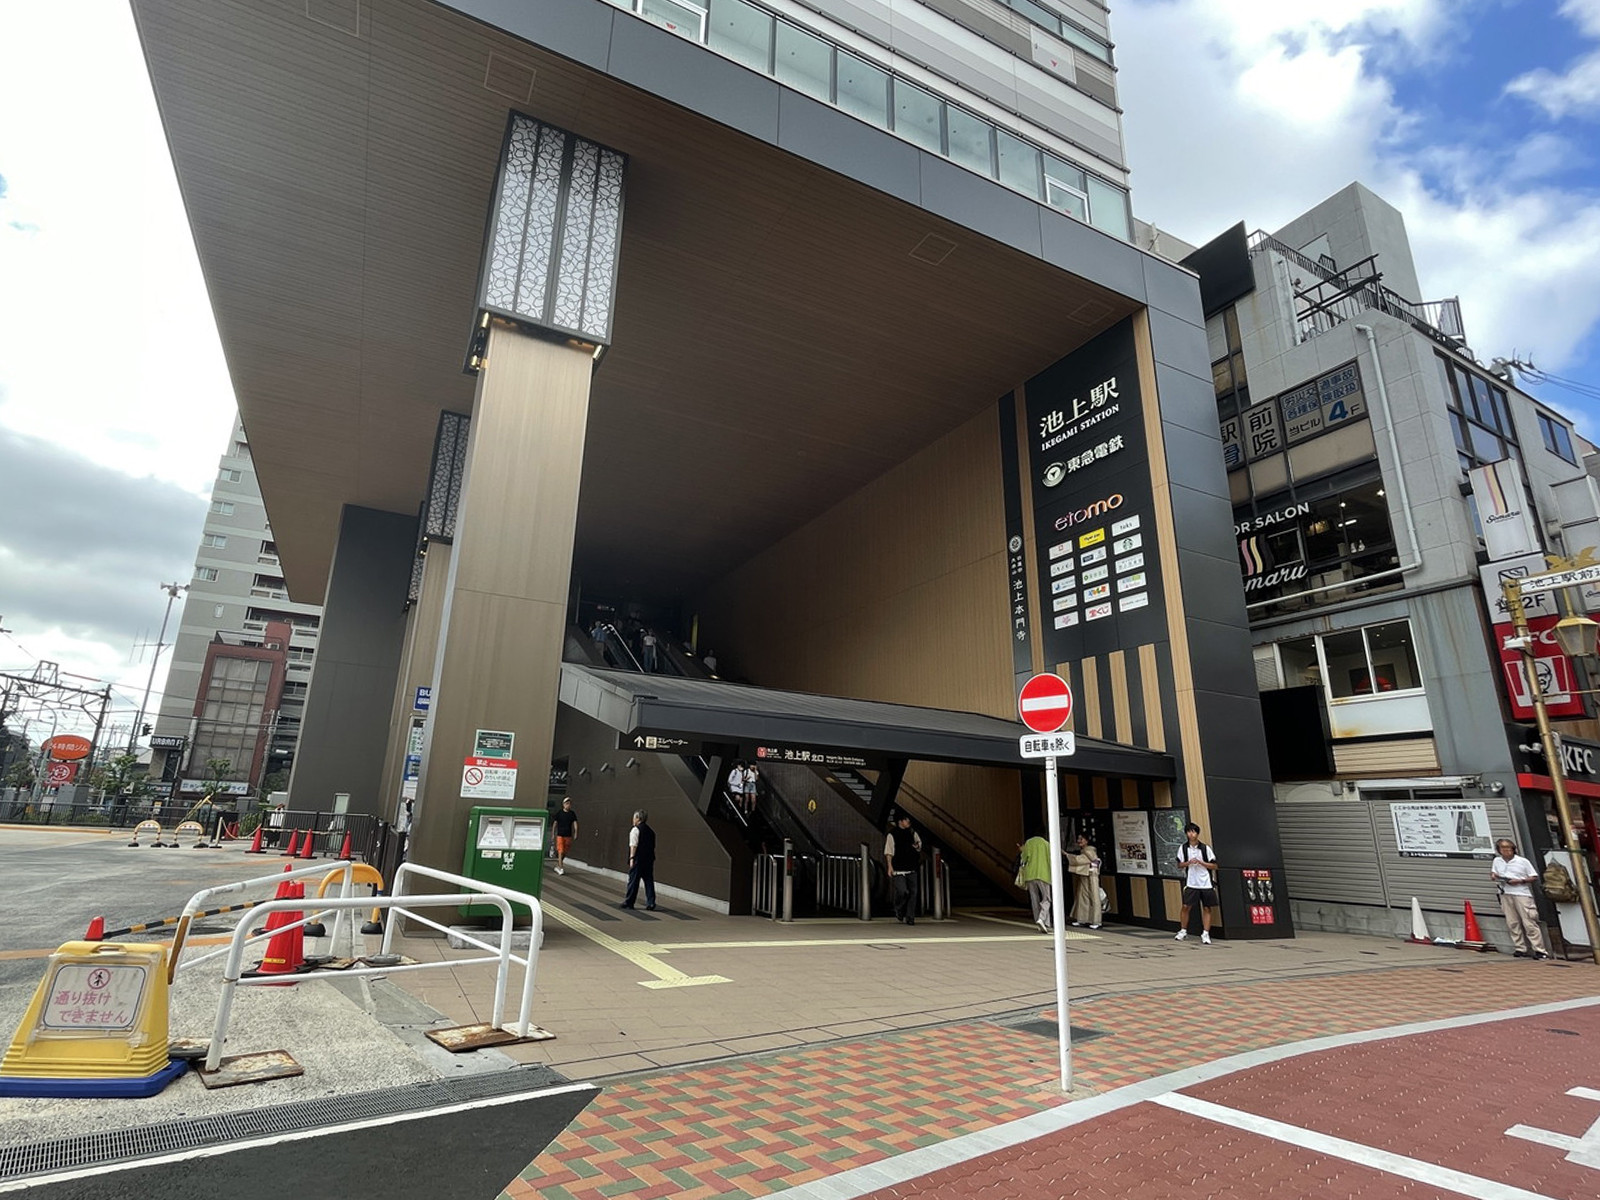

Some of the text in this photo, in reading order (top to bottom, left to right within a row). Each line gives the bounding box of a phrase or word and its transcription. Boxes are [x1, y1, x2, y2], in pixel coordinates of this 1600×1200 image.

[1039, 376, 1120, 438] 池上駅
[1288, 400, 1360, 436] 当ビル 4F
[1041, 403, 1120, 451] IKEGAMI STATION
[1066, 434, 1124, 474] 東急電鉄
[1054, 493, 1124, 531] etomo
[1255, 502, 1310, 529] SALON
[1088, 605, 1110, 618] 宝くじ
[1521, 593, 1546, 609] 2F
[152, 737, 176, 746] URBAN
[1024, 737, 1070, 753] 自転車を除く
[1561, 744, 1596, 776] KFC
[54, 990, 112, 1006] 通り抜け
[59, 1010, 128, 1024] できません
